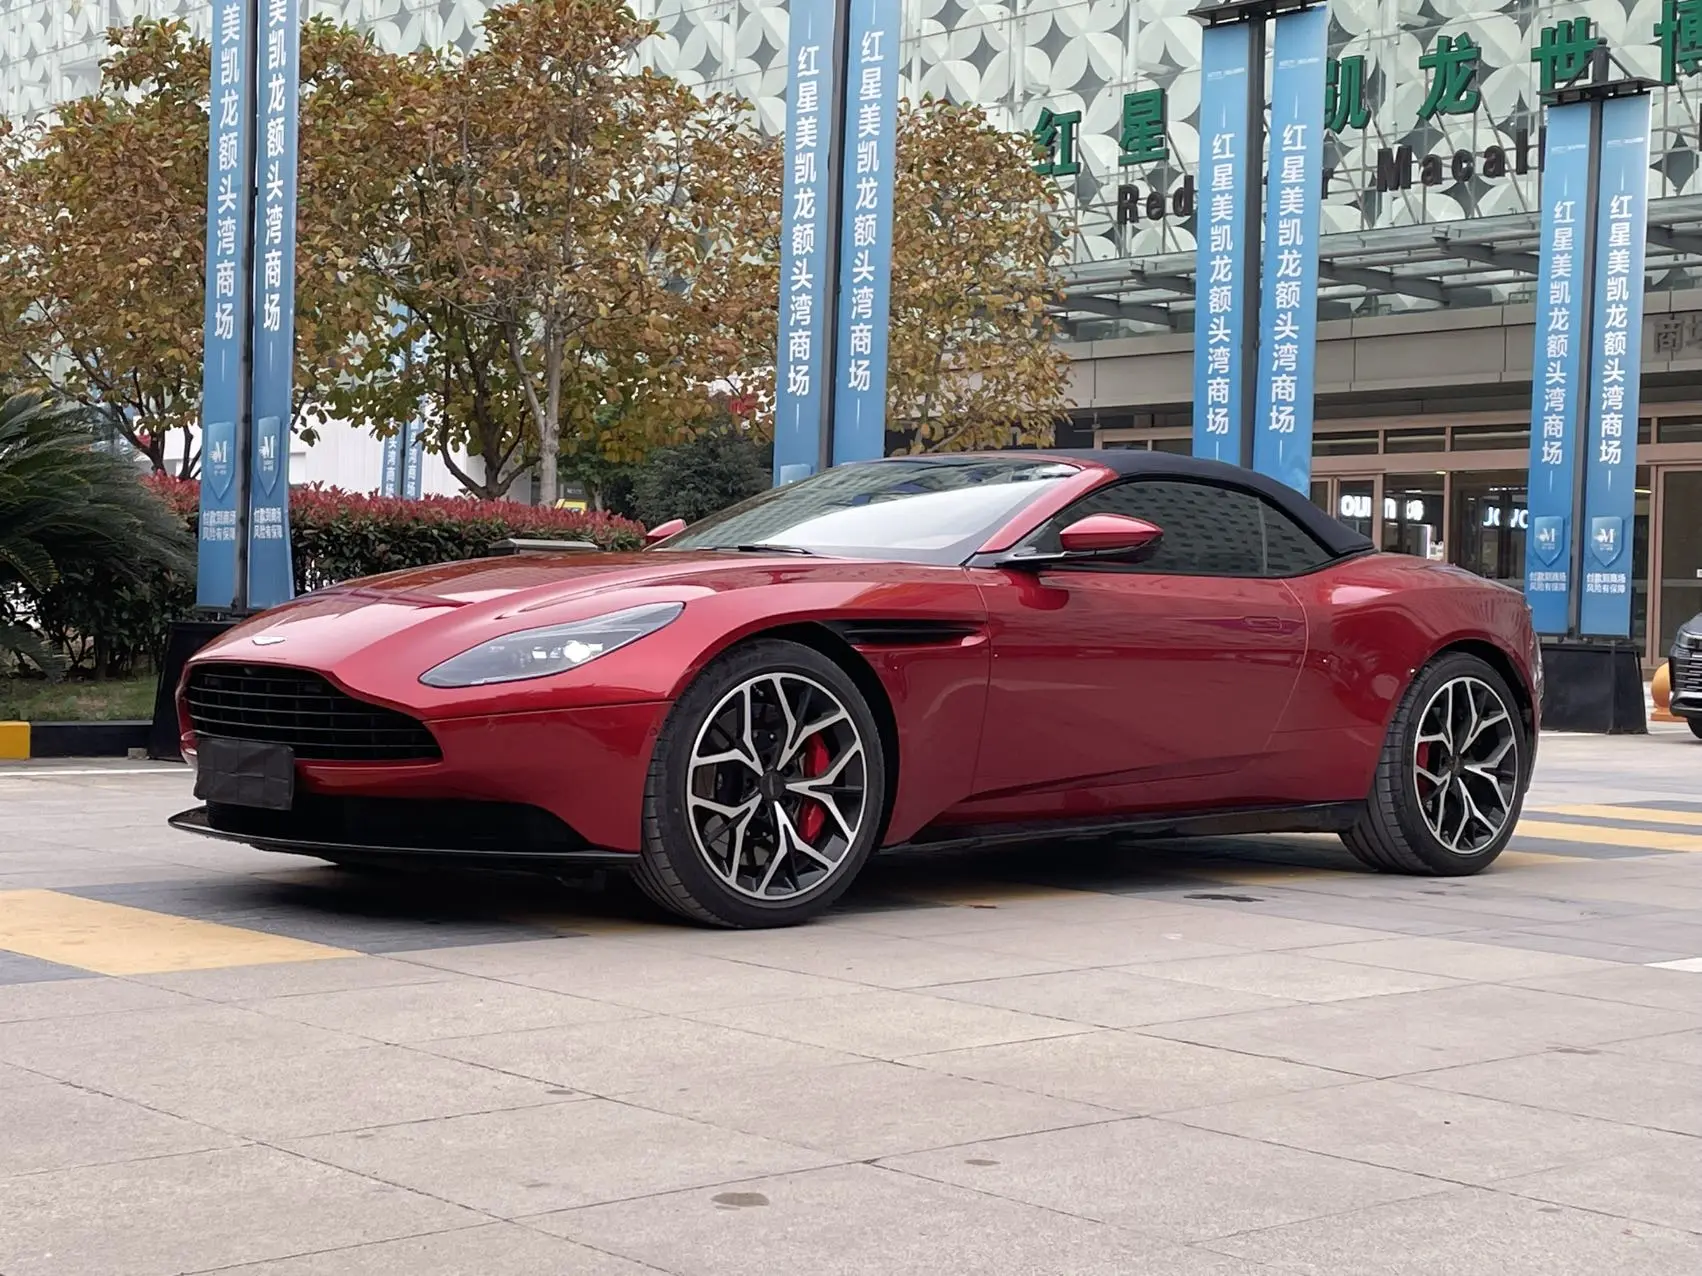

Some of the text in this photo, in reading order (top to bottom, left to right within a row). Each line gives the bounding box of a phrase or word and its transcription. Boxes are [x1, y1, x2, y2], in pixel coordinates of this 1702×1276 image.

[214, 4, 240, 341] 美凯龙额头湾商场
[787, 45, 820, 396] 红星美凯龙额头湾商场
[848, 30, 885, 393] 红星美凯龙额头湾商场
[1117, 175, 1196, 225] Red
[1206, 132, 1236, 436] 红星美凯龙额头湾商场
[1268, 123, 1308, 434] 红星美凯龙额头湾商场
[1541, 200, 1576, 465] 红星美凯龙额头湾商场
[1599, 195, 1633, 465] 红星美凯龙额头湾商场
